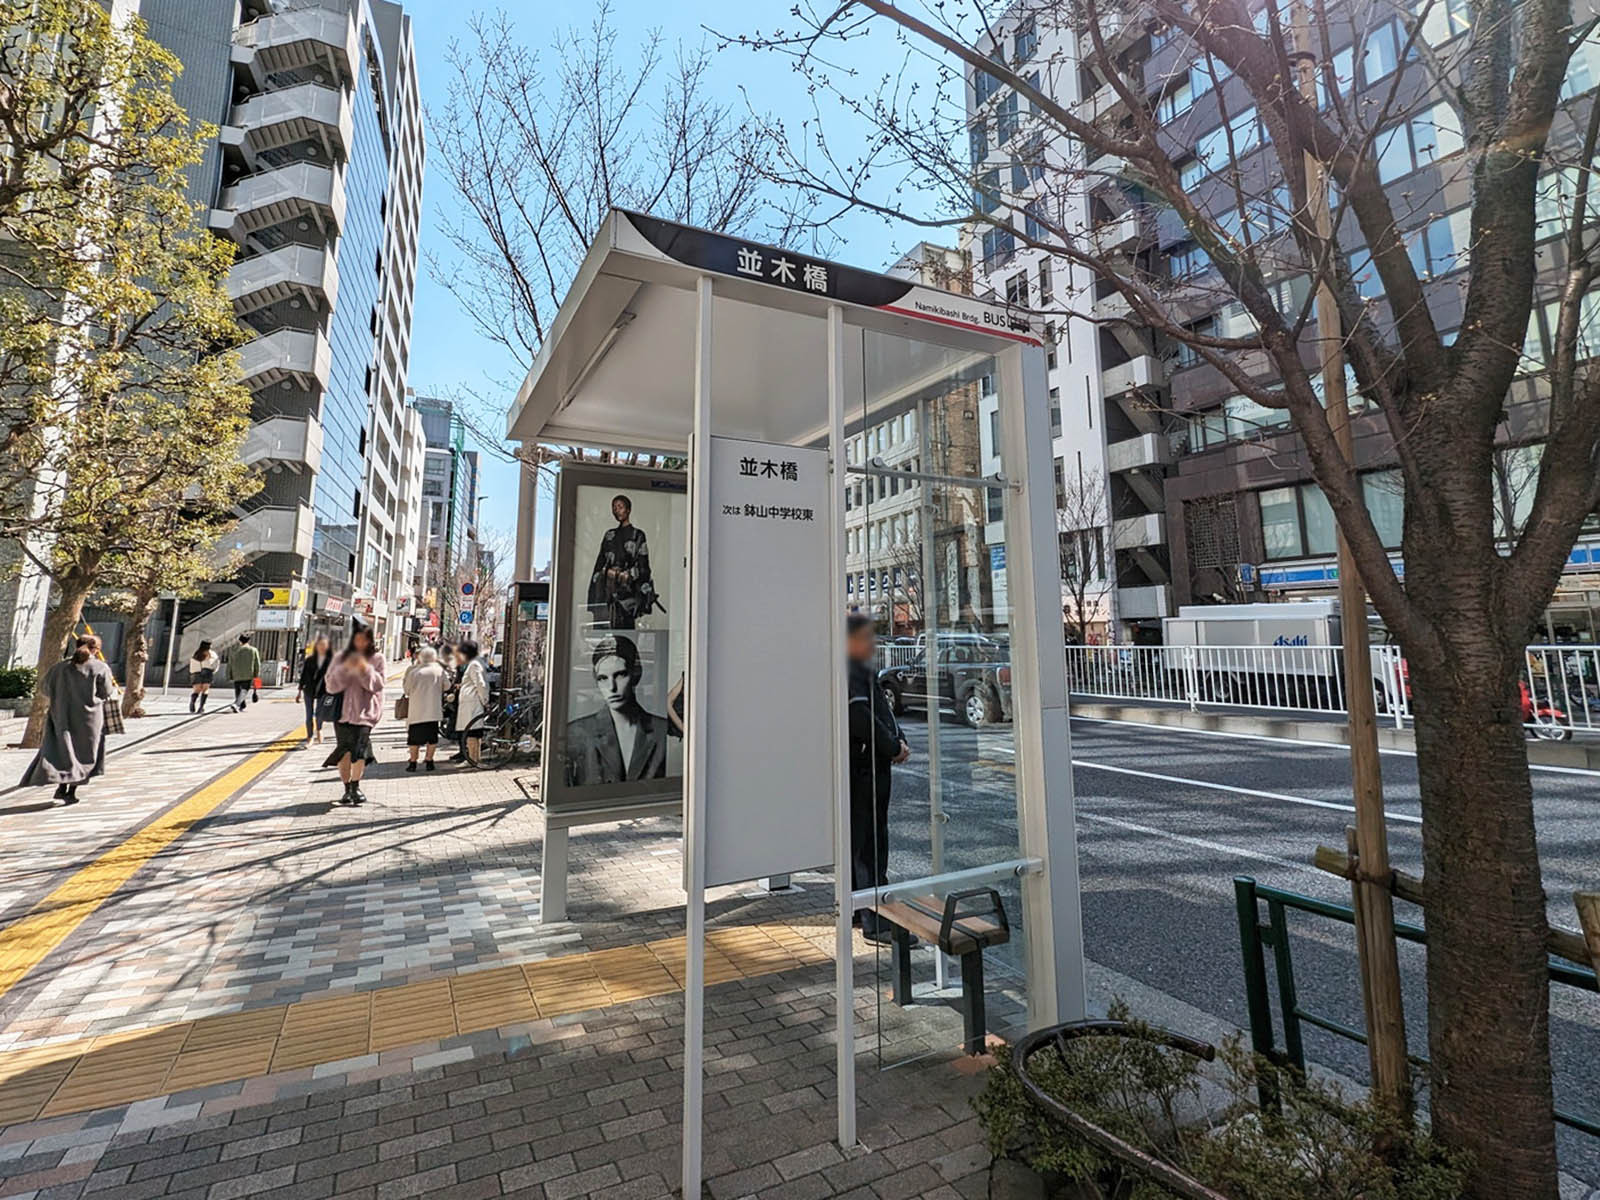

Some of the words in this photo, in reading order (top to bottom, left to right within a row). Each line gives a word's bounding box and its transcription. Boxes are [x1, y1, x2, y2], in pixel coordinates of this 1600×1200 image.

[736, 247, 828, 293] 並木橋
[914, 301, 960, 320] Namikibashi
[961, 312, 980, 325] Brdg.
[983, 311, 1006, 328] BUS
[739, 456, 798, 482] 並木橋
[722, 504, 741, 516] 次は
[743, 503, 814, 521] 鉢山中学校東
[1272, 634, 1308, 646] Asahi
